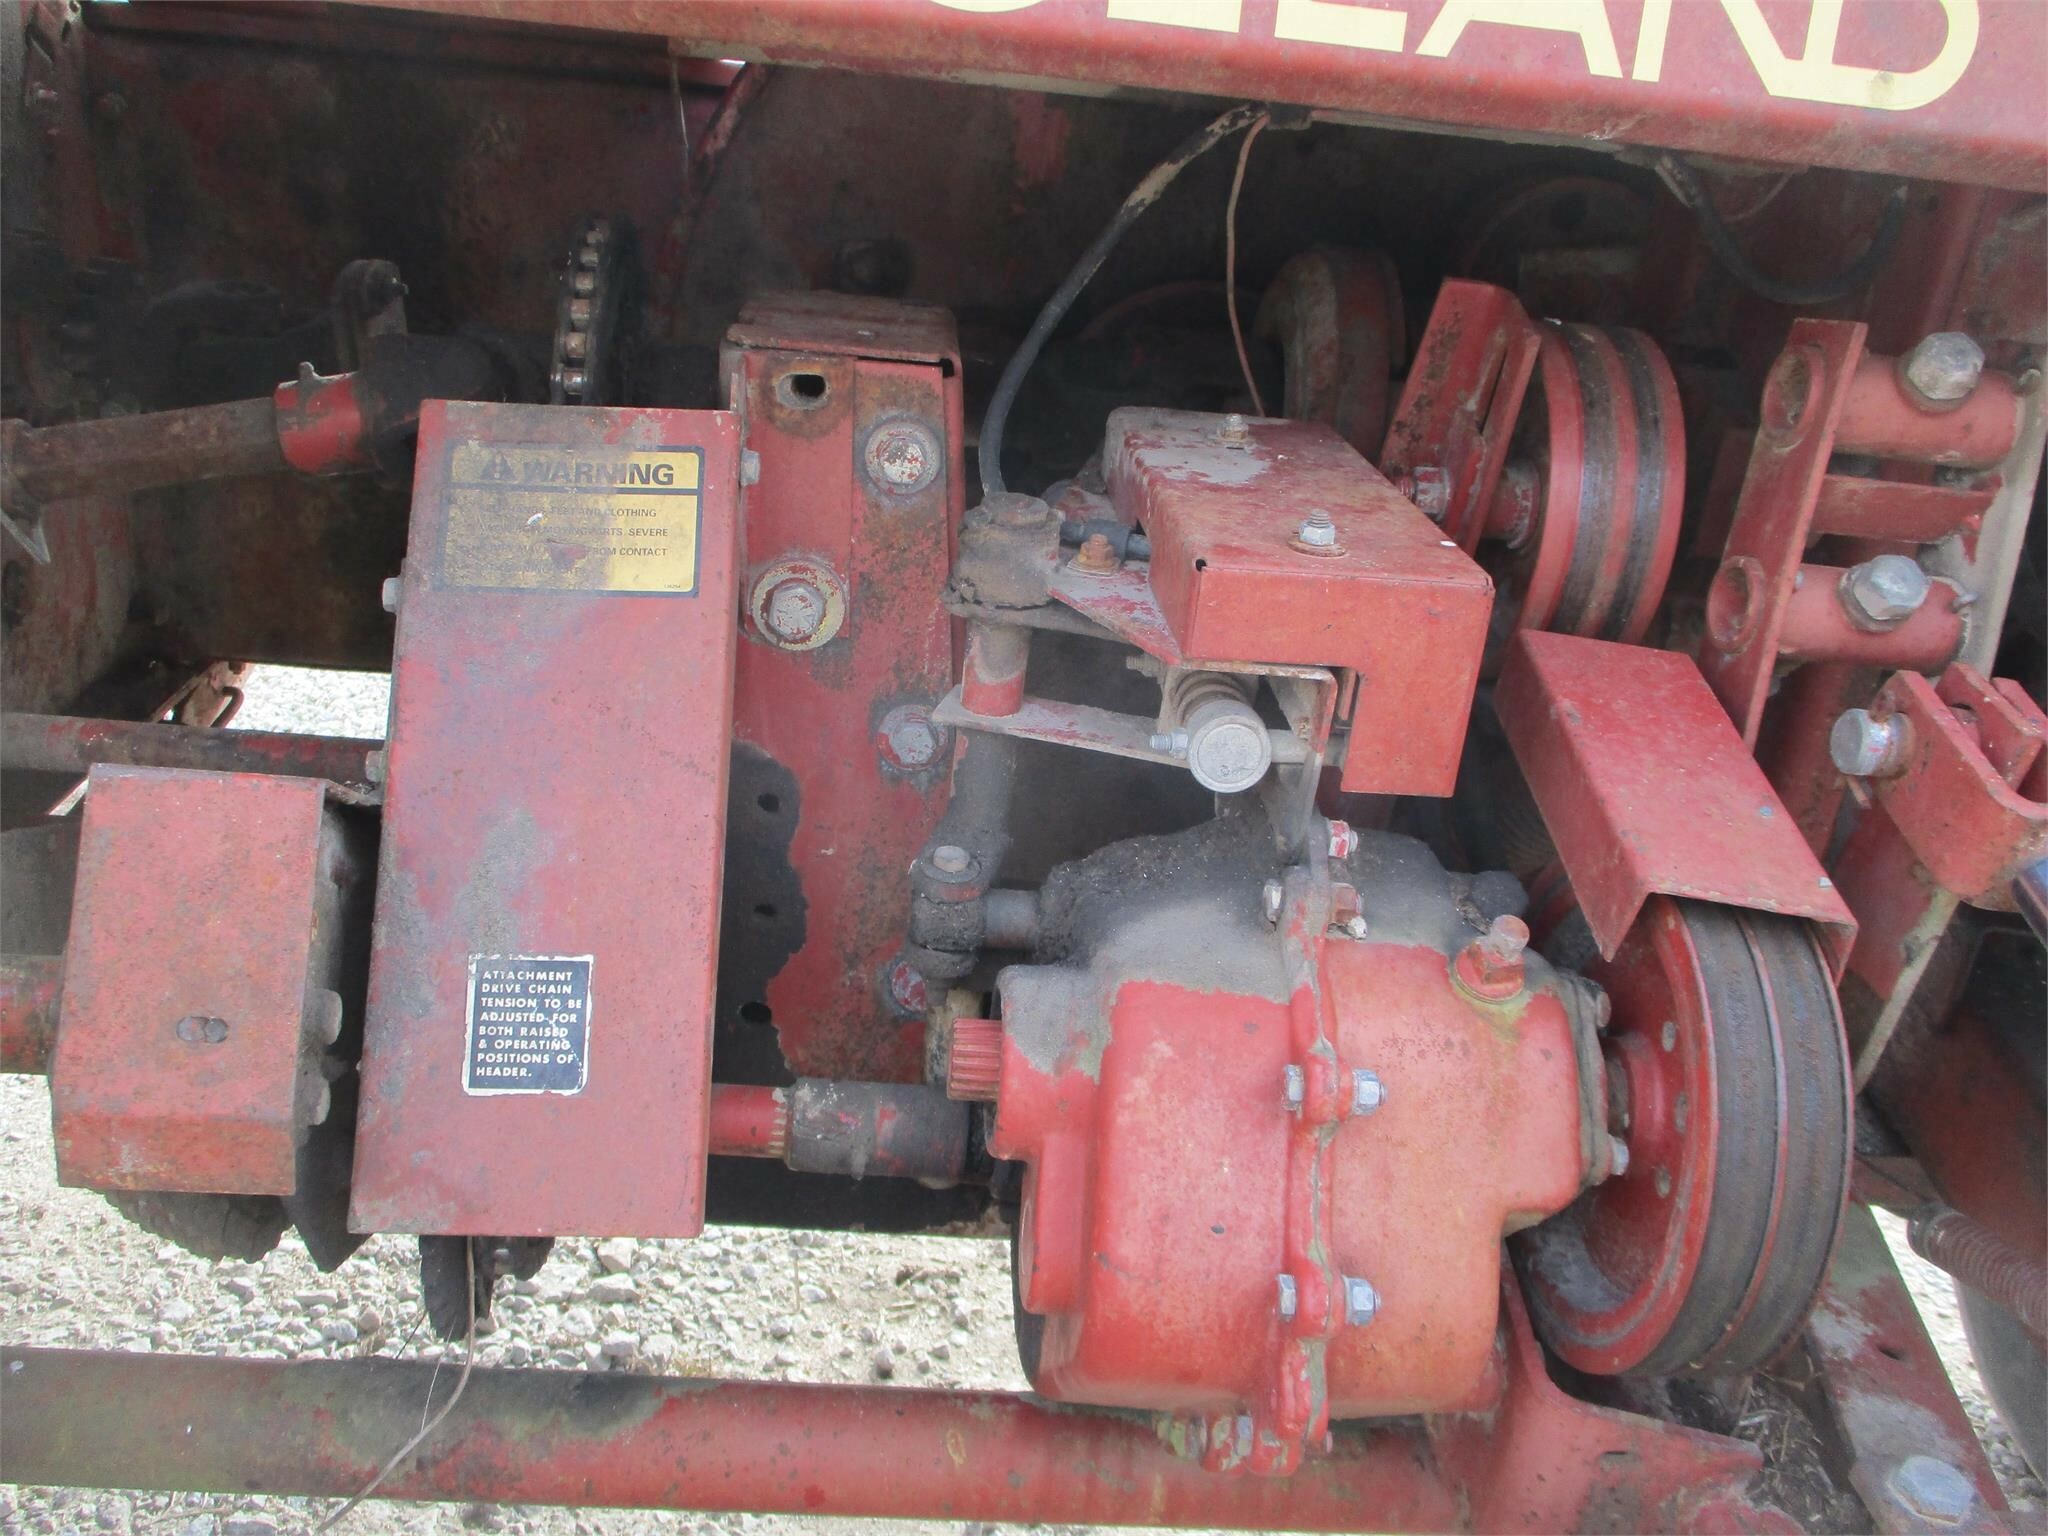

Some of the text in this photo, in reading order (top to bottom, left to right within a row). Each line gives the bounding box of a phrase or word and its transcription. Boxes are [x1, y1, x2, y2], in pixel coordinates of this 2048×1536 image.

[524, 462, 674, 486] WARNING
[606, 508, 657, 518] CLOTHING
[628, 527, 668, 538] SEVERE
[619, 547, 667, 557] CONTACT
[483, 970, 573, 981] ATTACHMENT
[481, 983, 572, 994] DRIVE CHAIN
[481, 997, 582, 1009] TENSION TO BE
[480, 1012, 577, 1023] ADJUSTED FOR
[479, 1026, 569, 1037] BOTH RAISED
[478, 1039, 571, 1050] & OPERATING
[477, 1053, 574, 1064] POSITIONS OF
[476, 1067, 532, 1077] HEADER.
